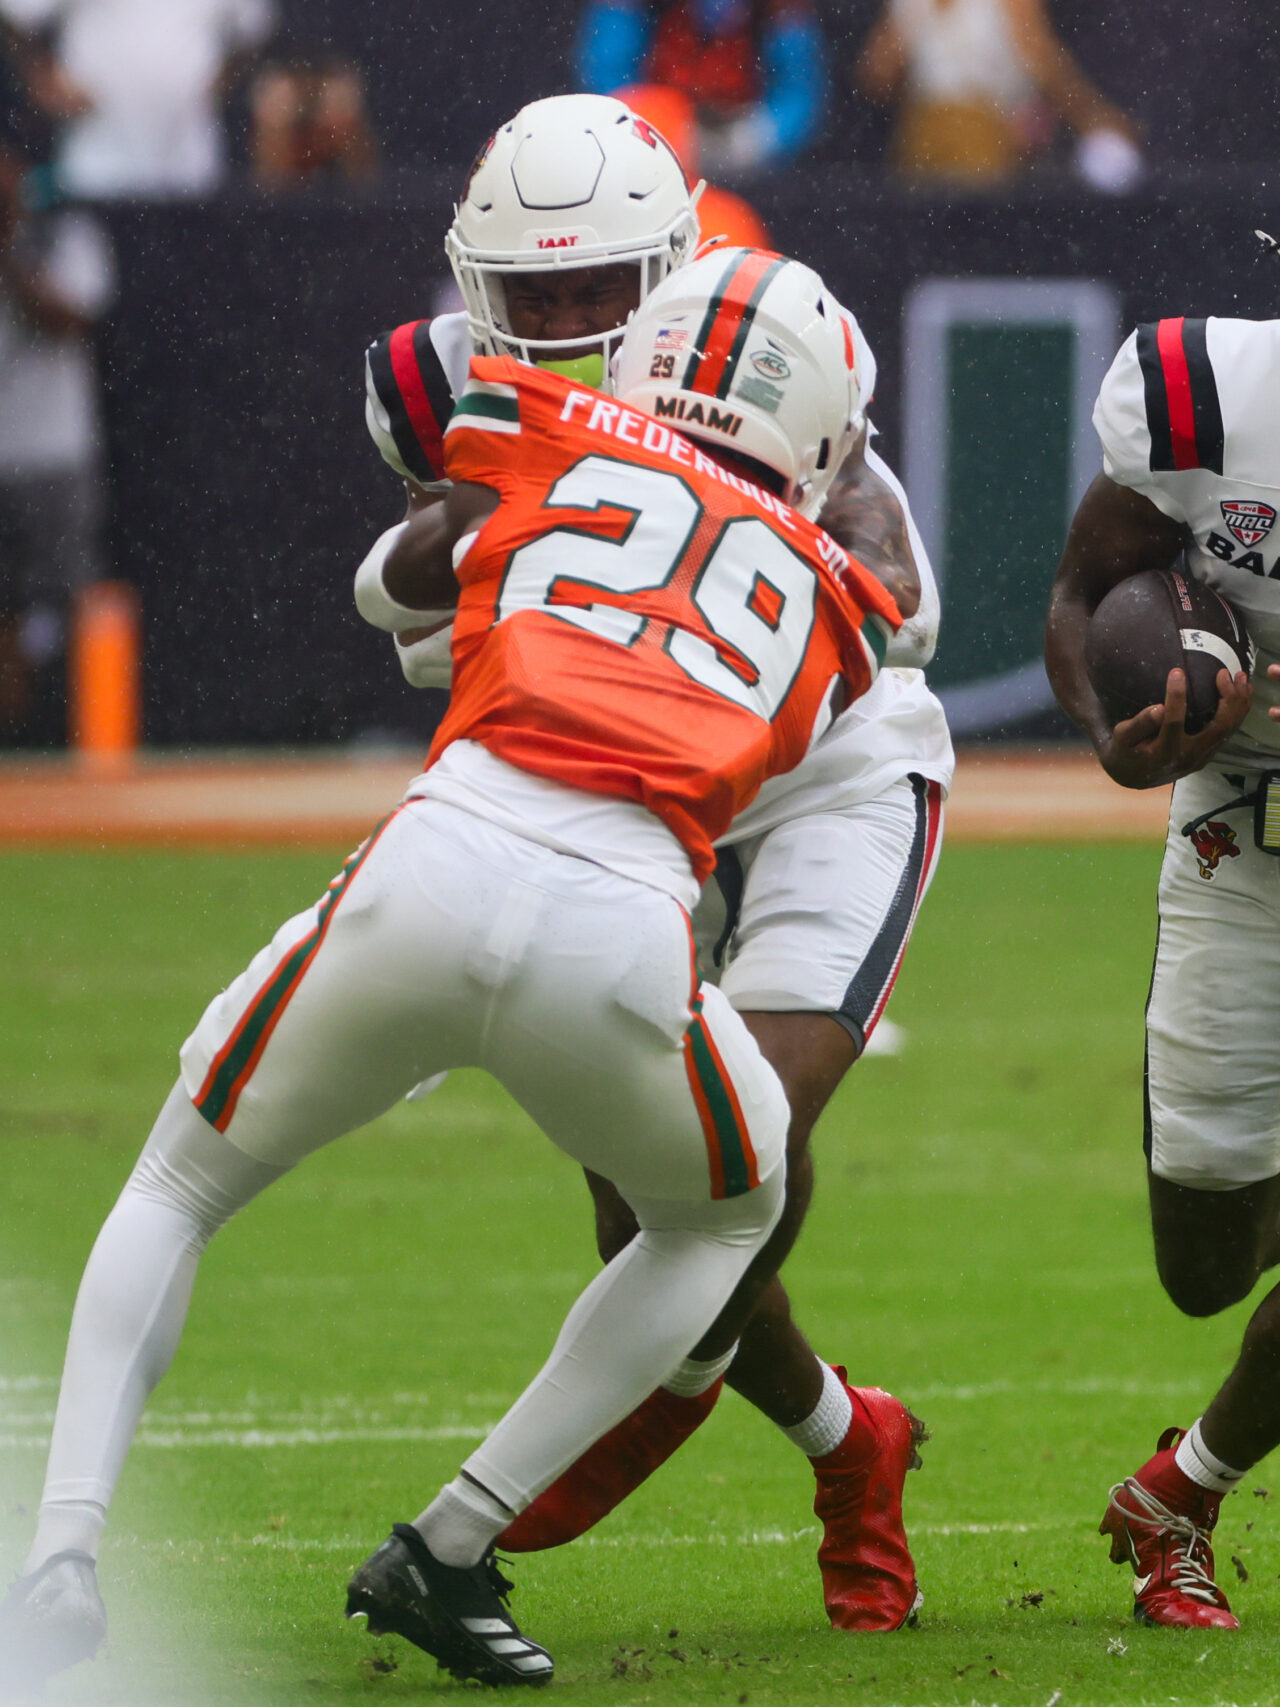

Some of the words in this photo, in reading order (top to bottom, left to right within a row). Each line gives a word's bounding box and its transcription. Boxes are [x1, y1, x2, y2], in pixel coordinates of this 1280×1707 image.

[537, 236, 579, 249] 1AAT
[650, 354, 676, 378] 29
[655, 396, 744, 437] MIAMI
[560, 390, 798, 532] FREDERIQUE
[1224, 512, 1272, 530] MAC
[489, 452, 819, 725] 29
